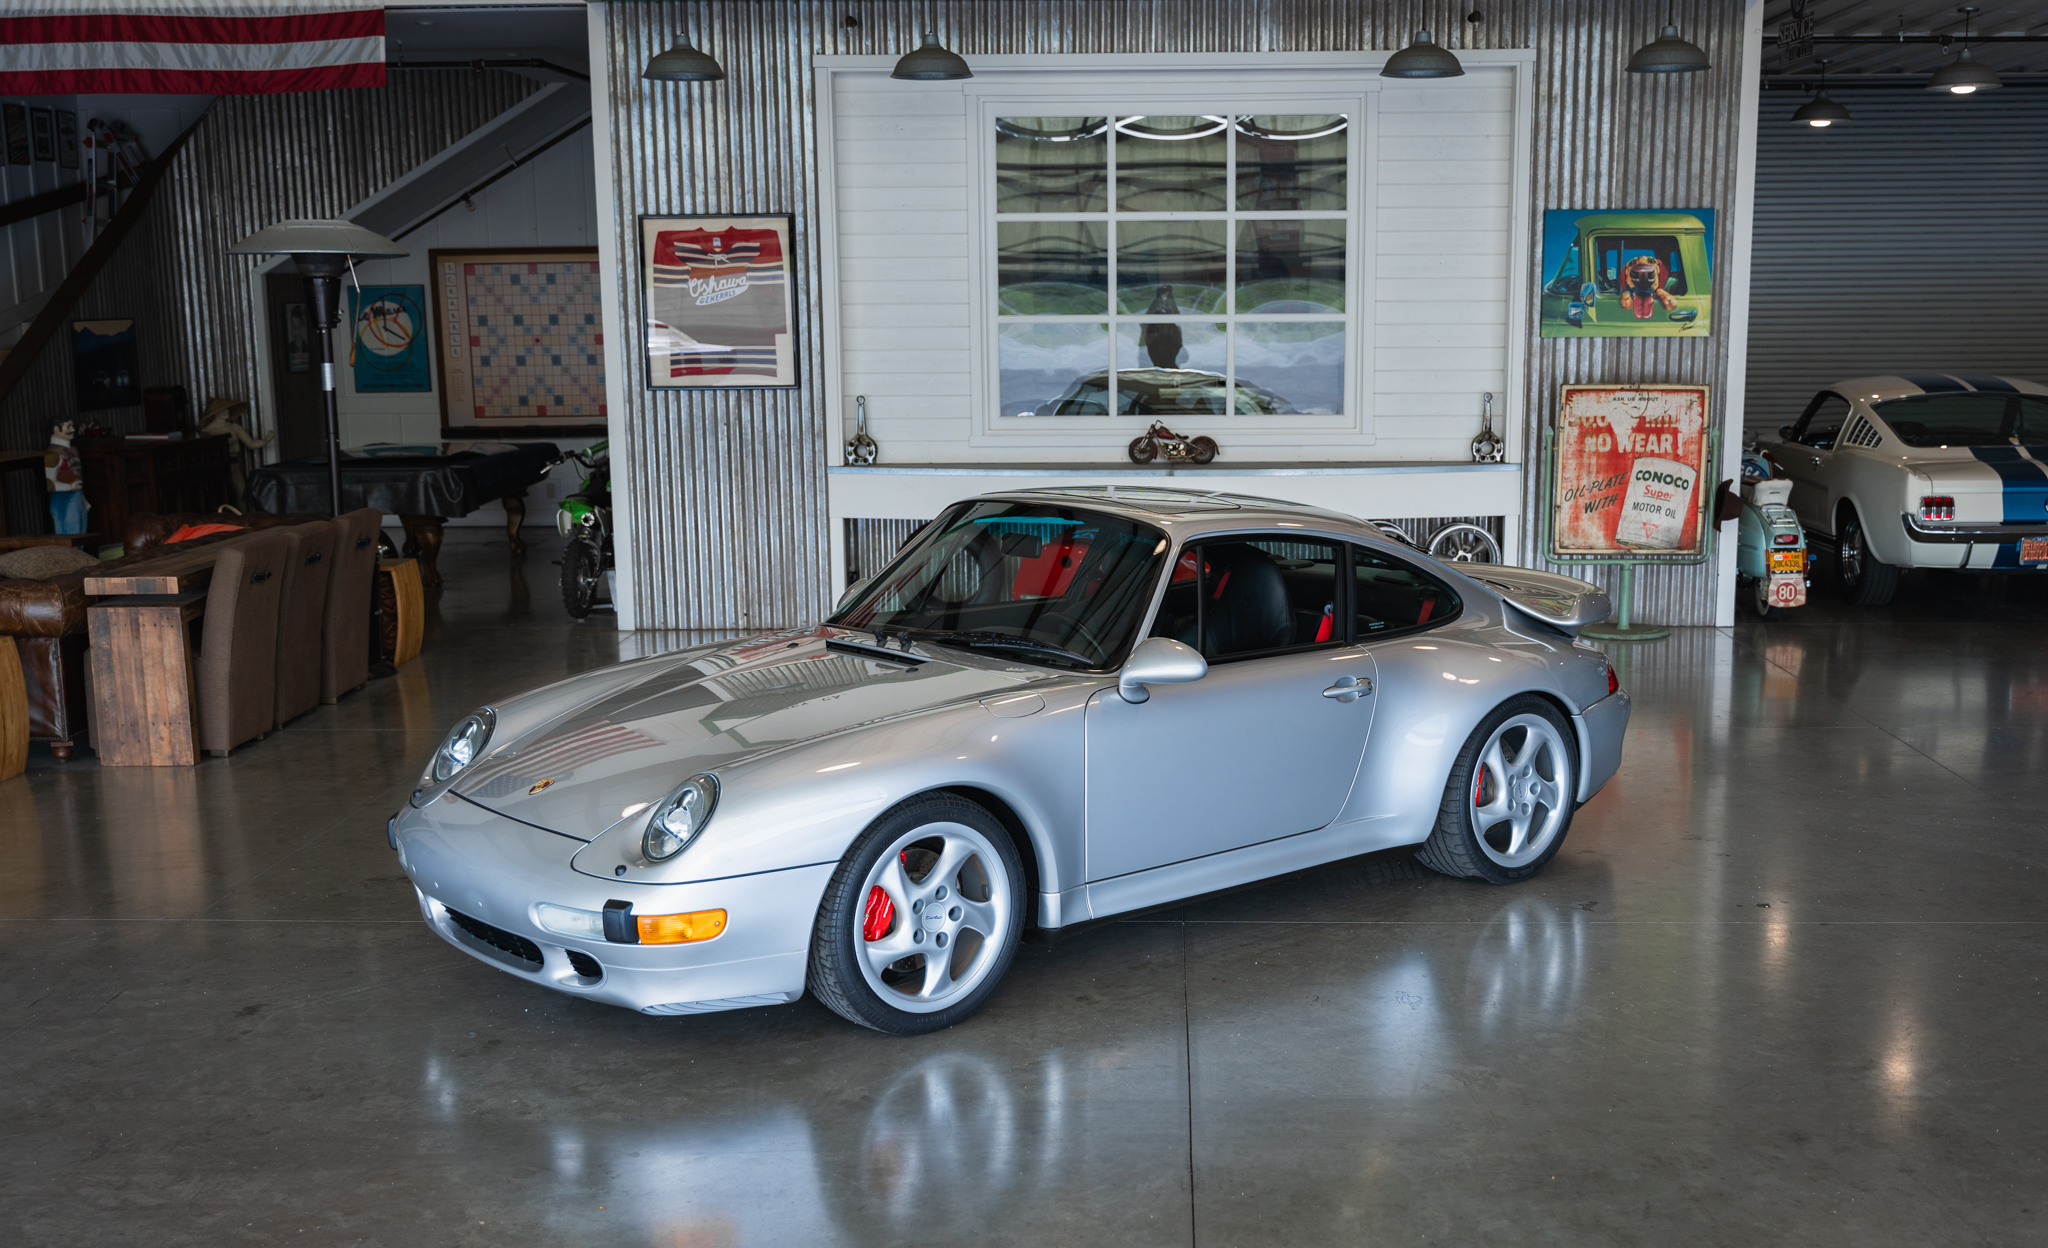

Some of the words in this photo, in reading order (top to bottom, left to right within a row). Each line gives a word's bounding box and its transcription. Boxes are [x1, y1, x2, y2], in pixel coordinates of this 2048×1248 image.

[1777, 14, 1814, 45] SERVICE
[688, 275, 749, 298] Oshawa
[699, 289, 736, 304] GENERALS
[1584, 432, 1612, 453] NO
[1564, 471, 1629, 502] OIL-PLATE
[1635, 470, 1690, 491] CONOCO
[1643, 484, 1674, 500] Super
[1584, 493, 1619, 515] WITH
[1631, 501, 1662, 515] MOTOR
[1664, 507, 1677, 519] OIL
[1778, 585, 1795, 600] 80
